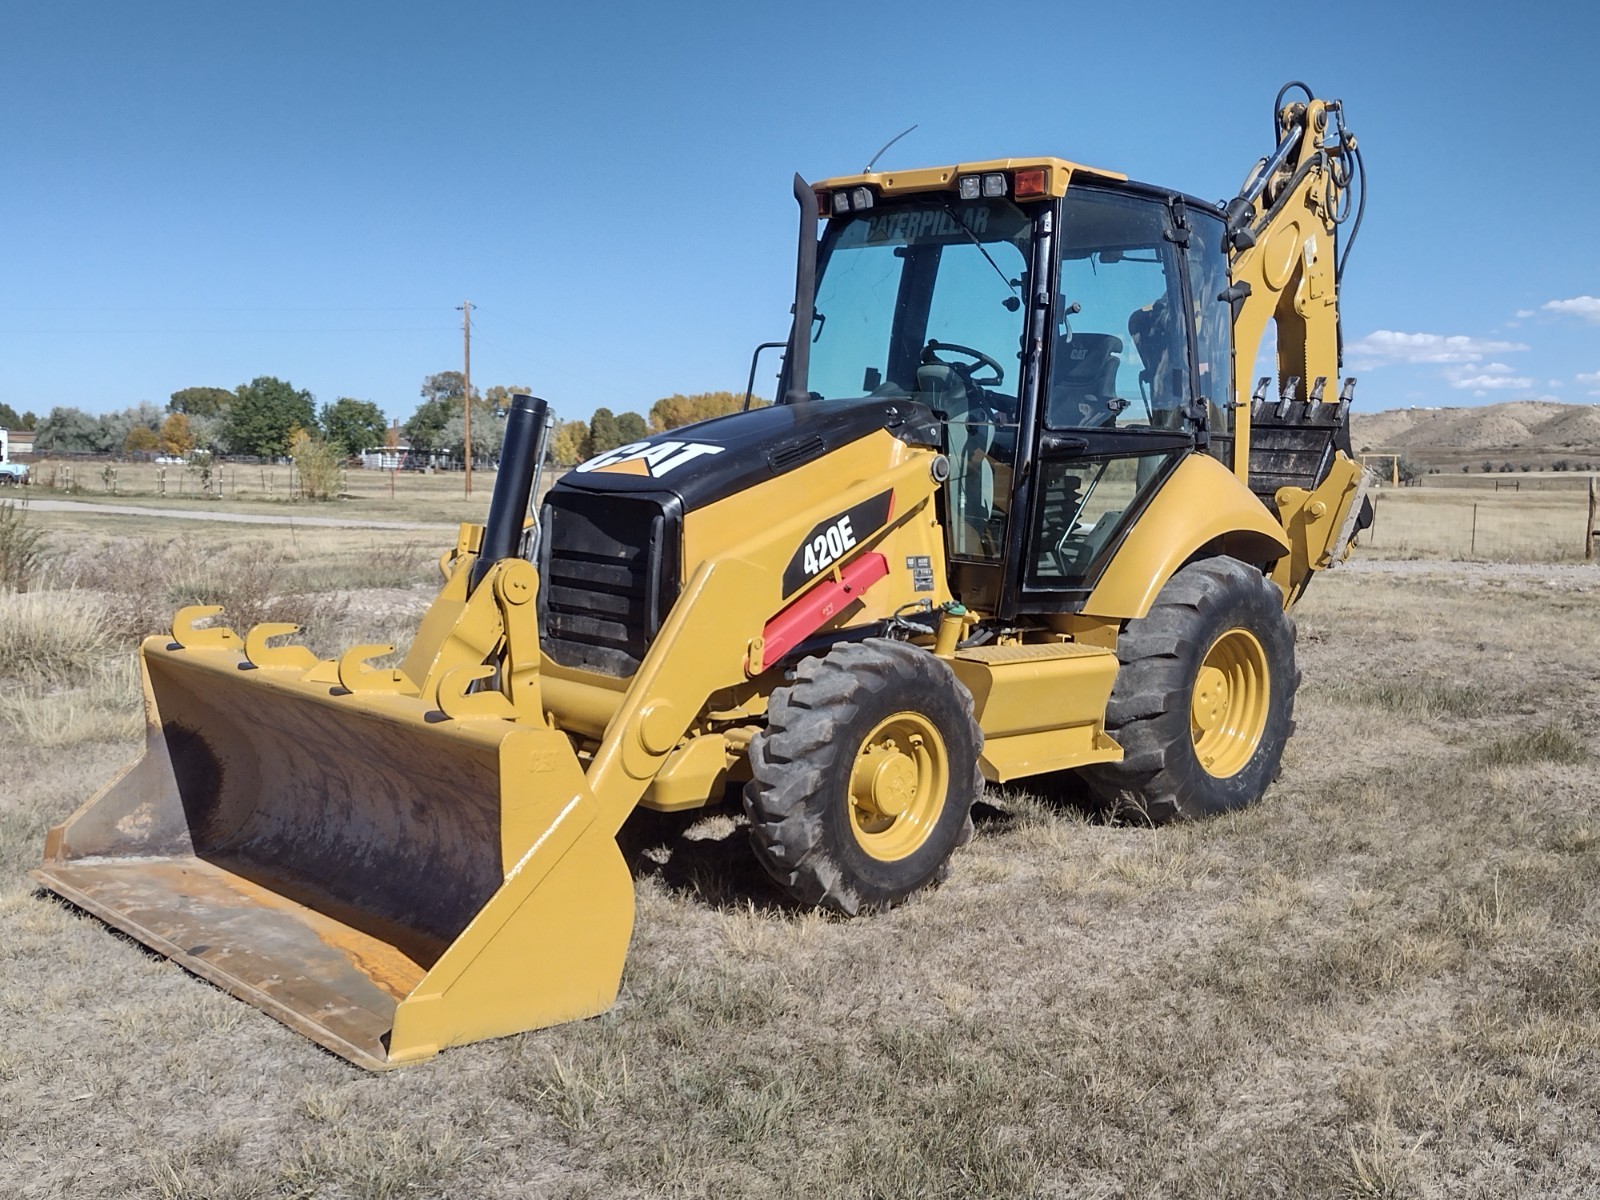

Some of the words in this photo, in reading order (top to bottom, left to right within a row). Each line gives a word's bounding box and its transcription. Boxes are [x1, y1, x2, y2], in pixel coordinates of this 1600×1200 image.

[868, 207, 990, 239] CATERPILLAR
[1070, 349, 1088, 360] CAT
[575, 441, 726, 478] CAT
[803, 514, 857, 575] 420E
